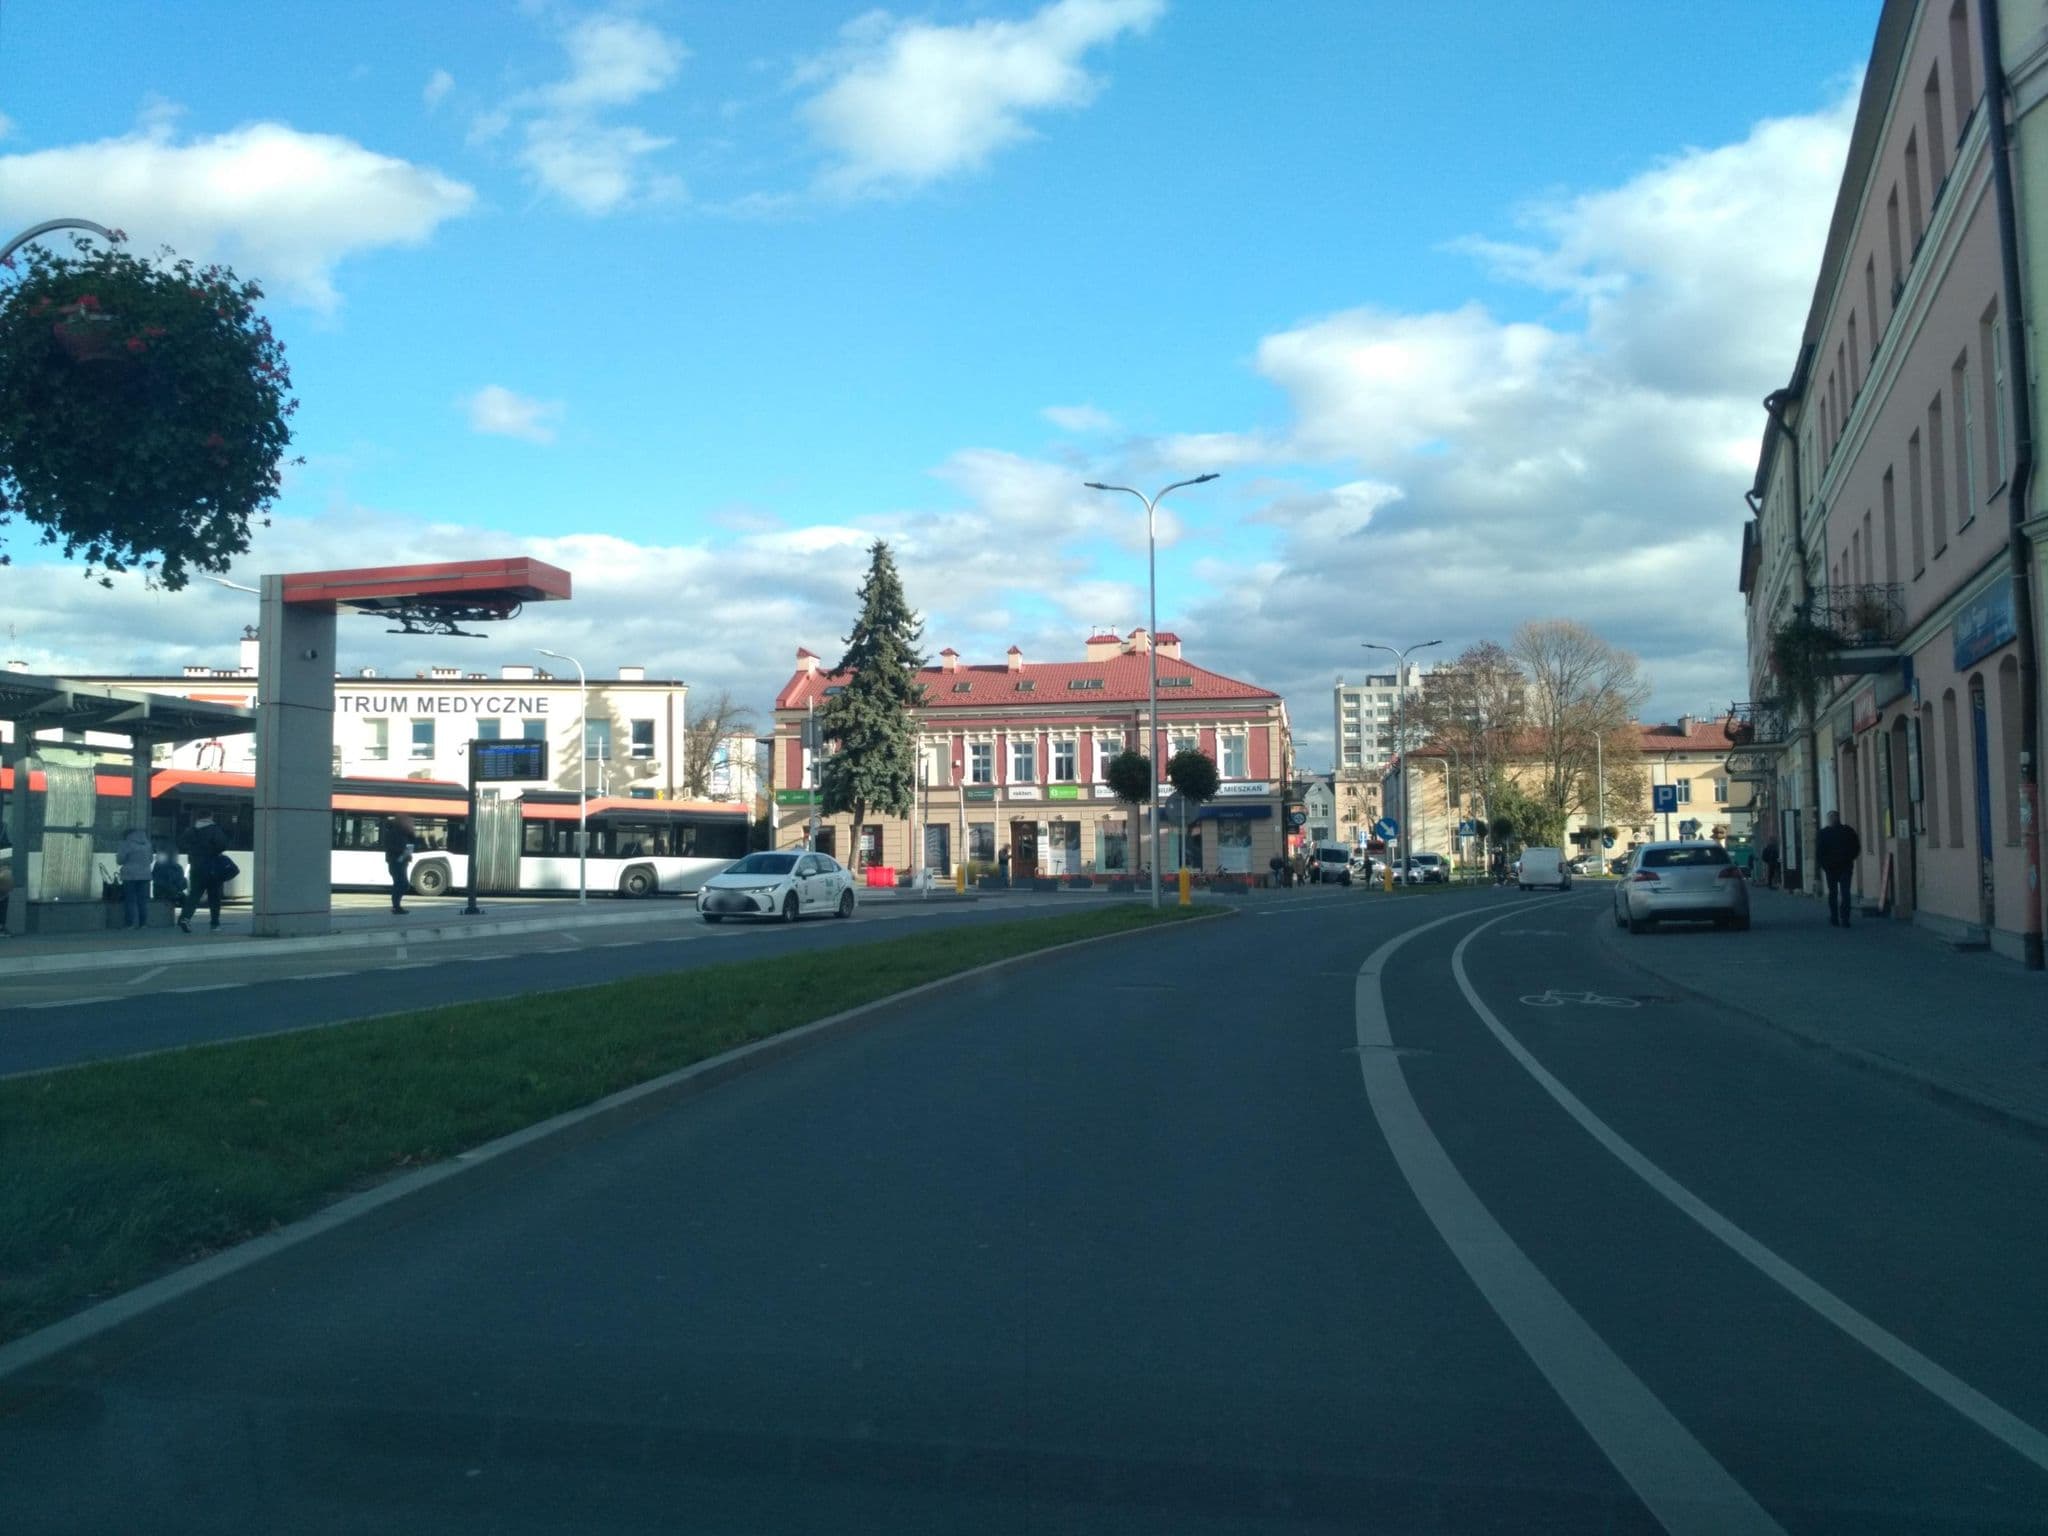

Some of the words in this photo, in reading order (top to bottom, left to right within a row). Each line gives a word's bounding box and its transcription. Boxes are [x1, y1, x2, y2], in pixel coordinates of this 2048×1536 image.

[333, 696, 408, 713] TRUM
[417, 696, 549, 713] MEDYCZNE
[1223, 784, 1263, 793] MIESZKAŃ
[1658, 787, 1673, 805] P
